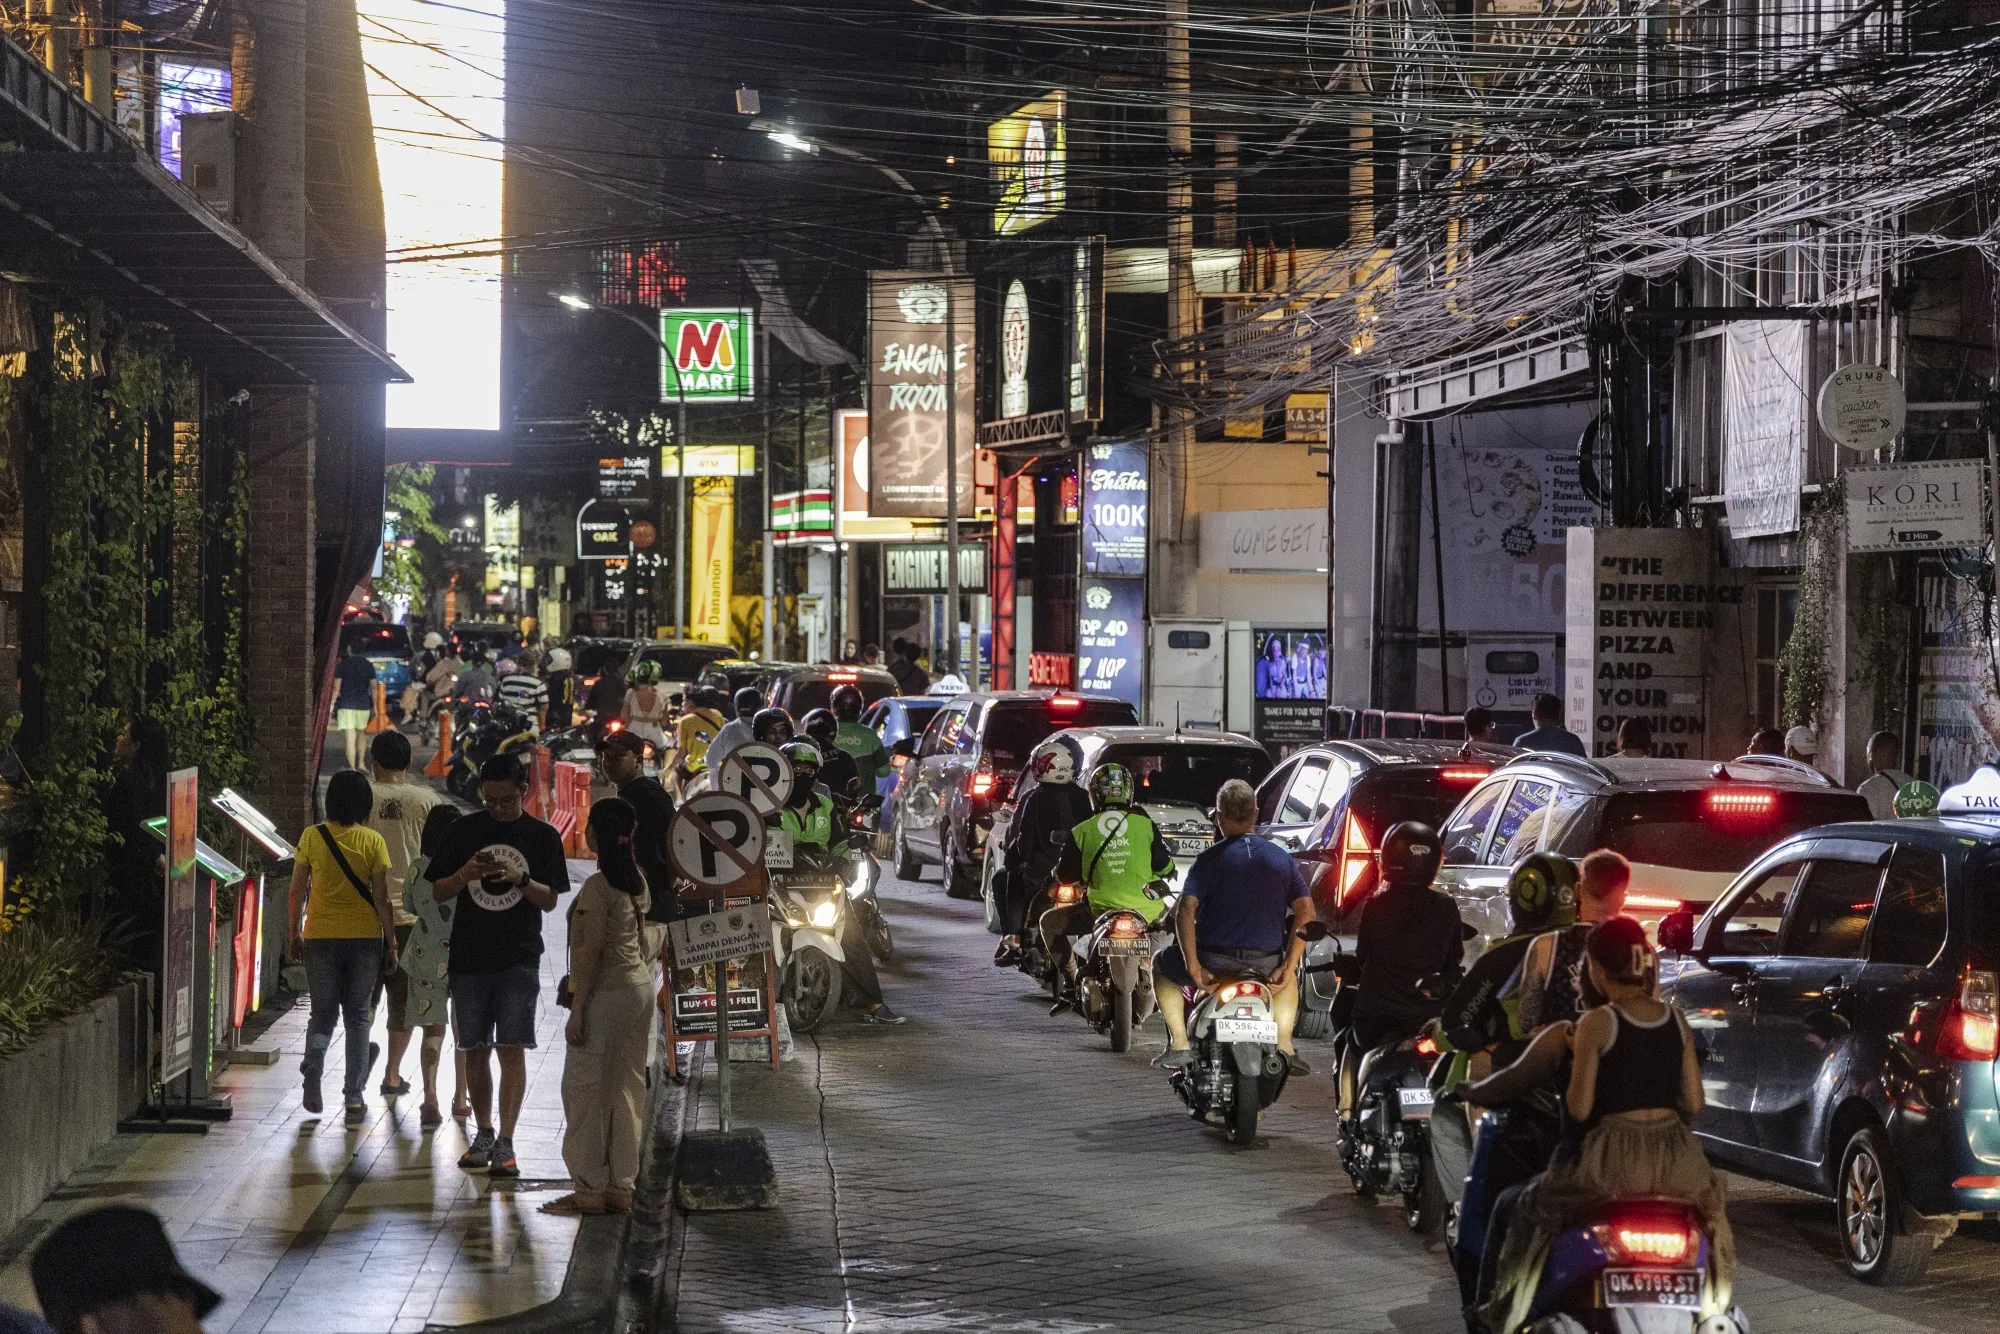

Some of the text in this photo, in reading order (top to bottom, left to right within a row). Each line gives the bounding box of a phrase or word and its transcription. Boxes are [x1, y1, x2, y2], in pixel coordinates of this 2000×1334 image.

[879, 343, 969, 376] ENGINE
[676, 372, 736, 391] MART
[1835, 371, 1883, 386] CRUMB
[1842, 399, 1881, 413] coaster
[909, 485, 935, 493] STREET
[1091, 469, 1148, 492] Shisha
[1867, 482, 1962, 506] KORI
[1093, 504, 1147, 527] 100K
[1552, 503, 1594, 514] Supreme
[1867, 504, 1931, 513] RESTAURANT
[1551, 516, 1577, 526] Pesto
[592, 532, 618, 543] OAK
[1232, 525, 1277, 556] COME
[1280, 522, 1316, 556] GET
[1905, 532, 1929, 541] 3 Min
[886, 549, 985, 589] ENGINE ROM
[708, 559, 722, 626] Danamon
[1599, 583, 1745, 604] DIFFERENCE
[1104, 619, 1128, 637] 40
[1599, 609, 1714, 630] BETWEEN
[1599, 635, 1675, 655] PIZZA
[1096, 656, 1127, 679] HOP
[1597, 661, 1653, 681] AND
[940, 684, 963, 692] TAKSI
[1573, 696, 1586, 712] DAY
[1597, 688, 1668, 707] YOUR
[1570, 718, 1588, 735] PIZZA
[741, 756, 781, 801] P
[1899, 795, 1933, 810] Grab
[697, 808, 750, 878] P
[1107, 859, 1127, 867] gopay
[472, 888, 518, 908] ENGLAND
[685, 931, 761, 955] SAMPAI DENGAN
[1099, 940, 1110, 948] DK
[680, 941, 772, 967] RAMBU BERIKUTNYA
[683, 1000, 701, 1009] BUY
[736, 996, 757, 1005] FREE
[1218, 1020, 1231, 1030] DK
[1711, 1054, 1724, 1062] TAXI
[1404, 1092, 1417, 1103] DK
[1611, 1274, 1633, 1292] DK
